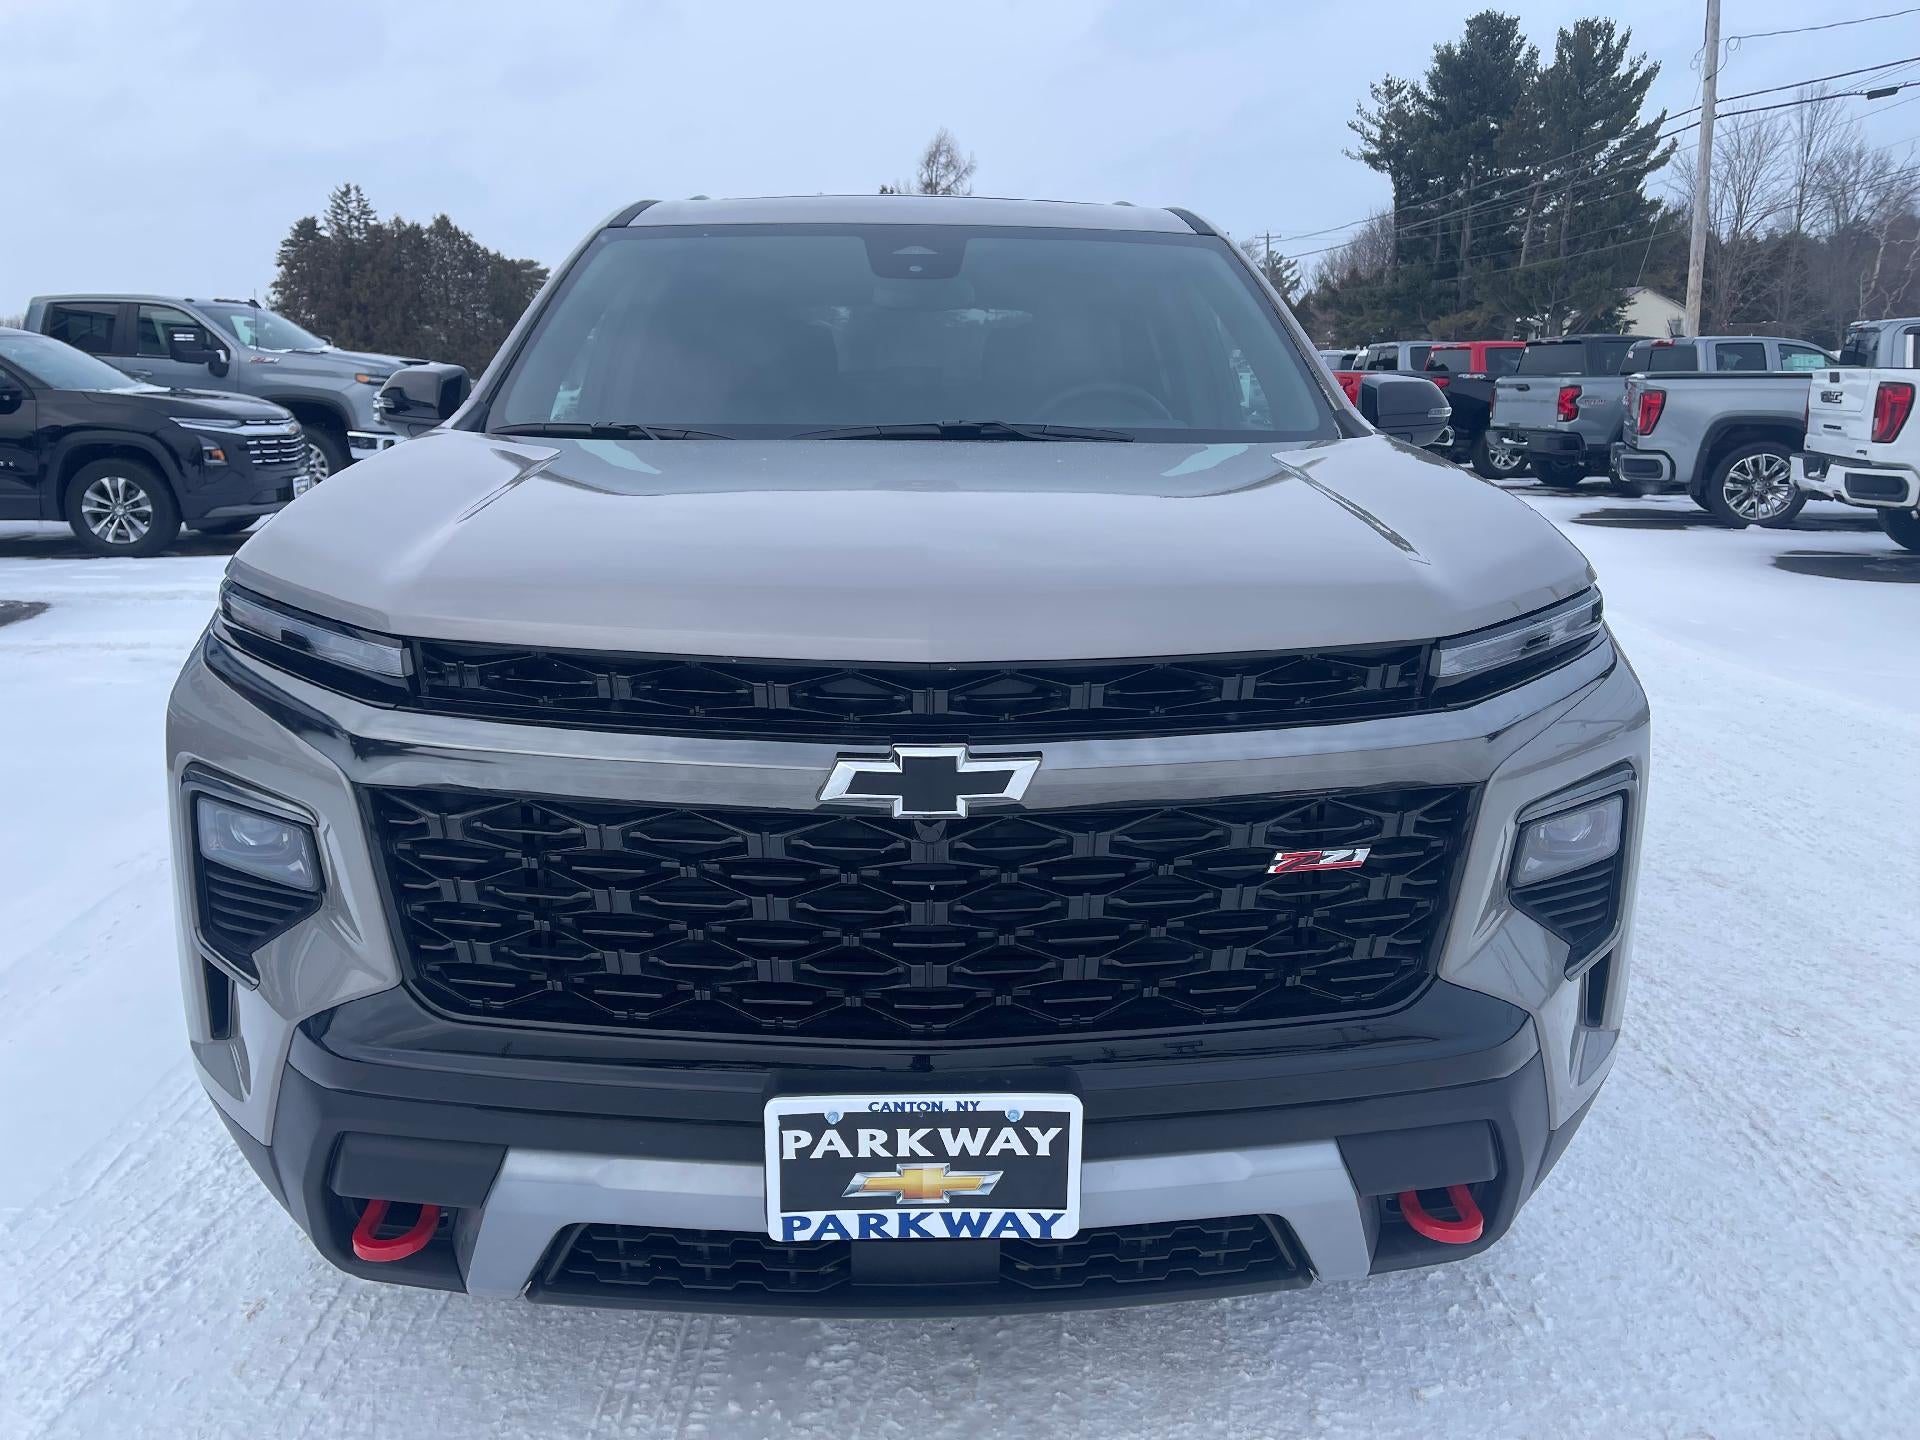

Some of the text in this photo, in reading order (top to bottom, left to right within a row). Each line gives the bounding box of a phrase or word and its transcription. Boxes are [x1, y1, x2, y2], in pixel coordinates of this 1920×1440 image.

[1267, 847, 1371, 874] Z71
[867, 1100, 981, 1113] CANTON, NY
[781, 1127, 1063, 1160] PARKWAY
[781, 1211, 1067, 1241] PARKWAY
